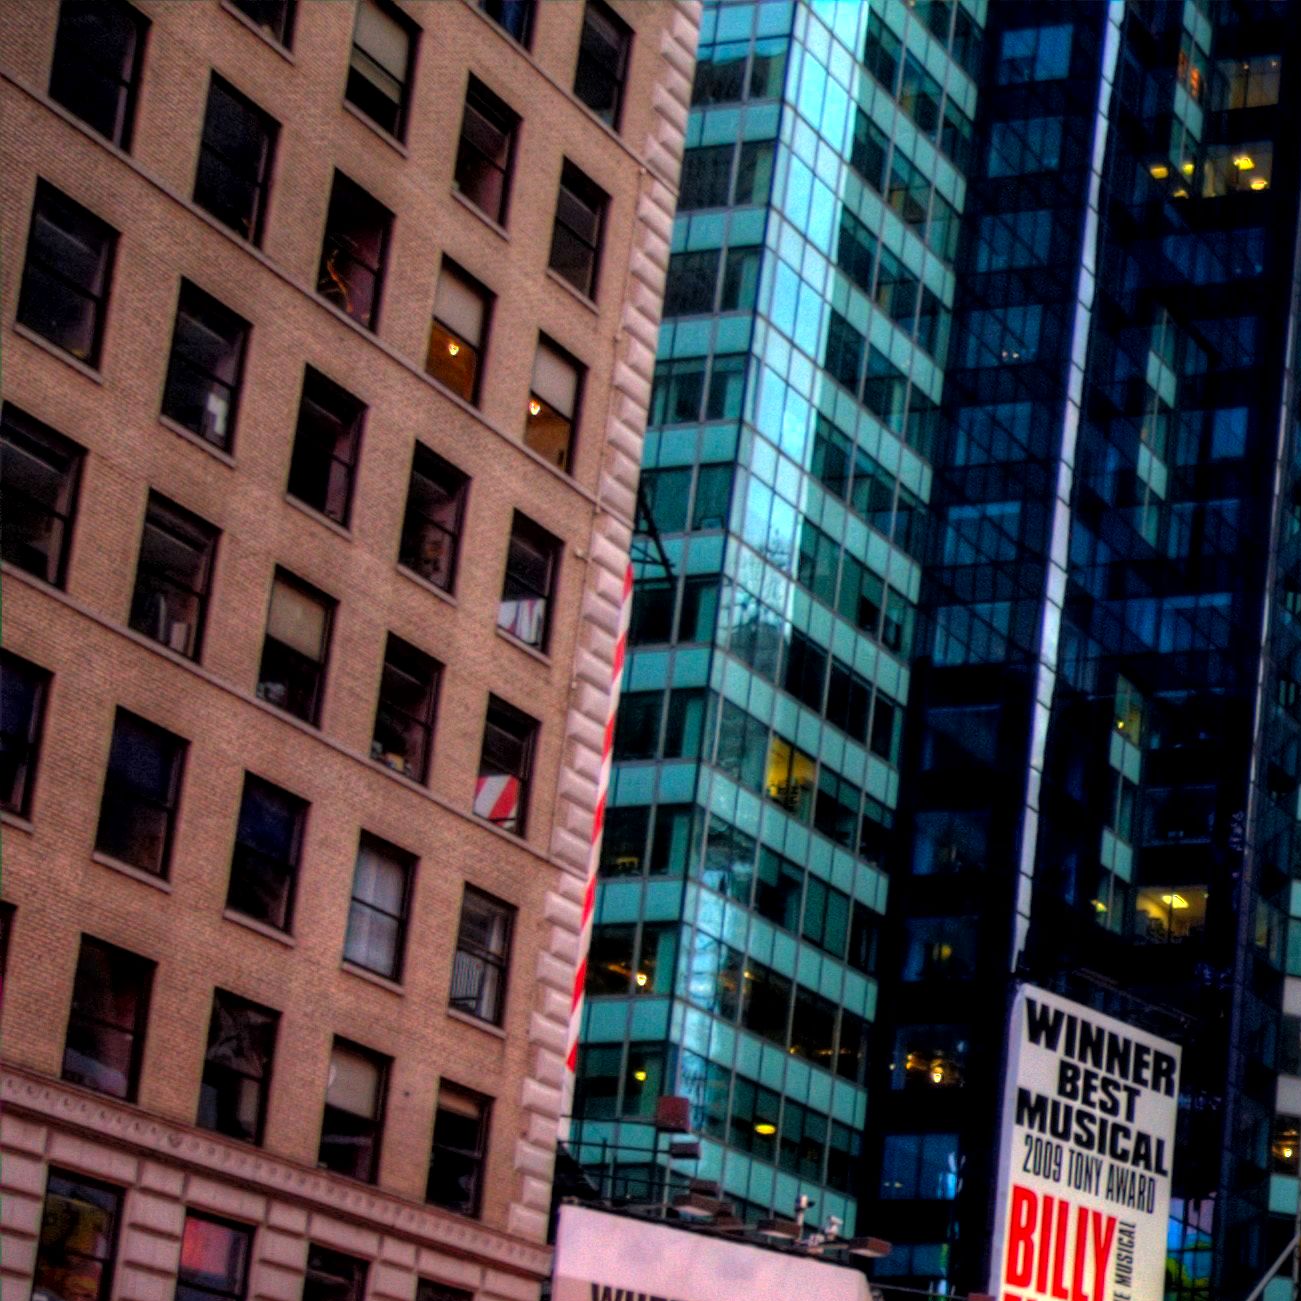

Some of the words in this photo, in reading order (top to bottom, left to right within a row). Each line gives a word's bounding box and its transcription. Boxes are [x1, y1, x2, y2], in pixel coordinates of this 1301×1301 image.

[1025, 996, 1178, 1098] WINNER
[1014, 1086, 1169, 1177] MUSICAL
[1057, 1058, 1142, 1124] BEST
[1022, 1134, 1062, 1184] 2009
[1067, 1148, 1102, 1198] TONY
[1105, 1161, 1156, 1215] AWARD
[1114, 1219, 1138, 1288] MUSICAL
